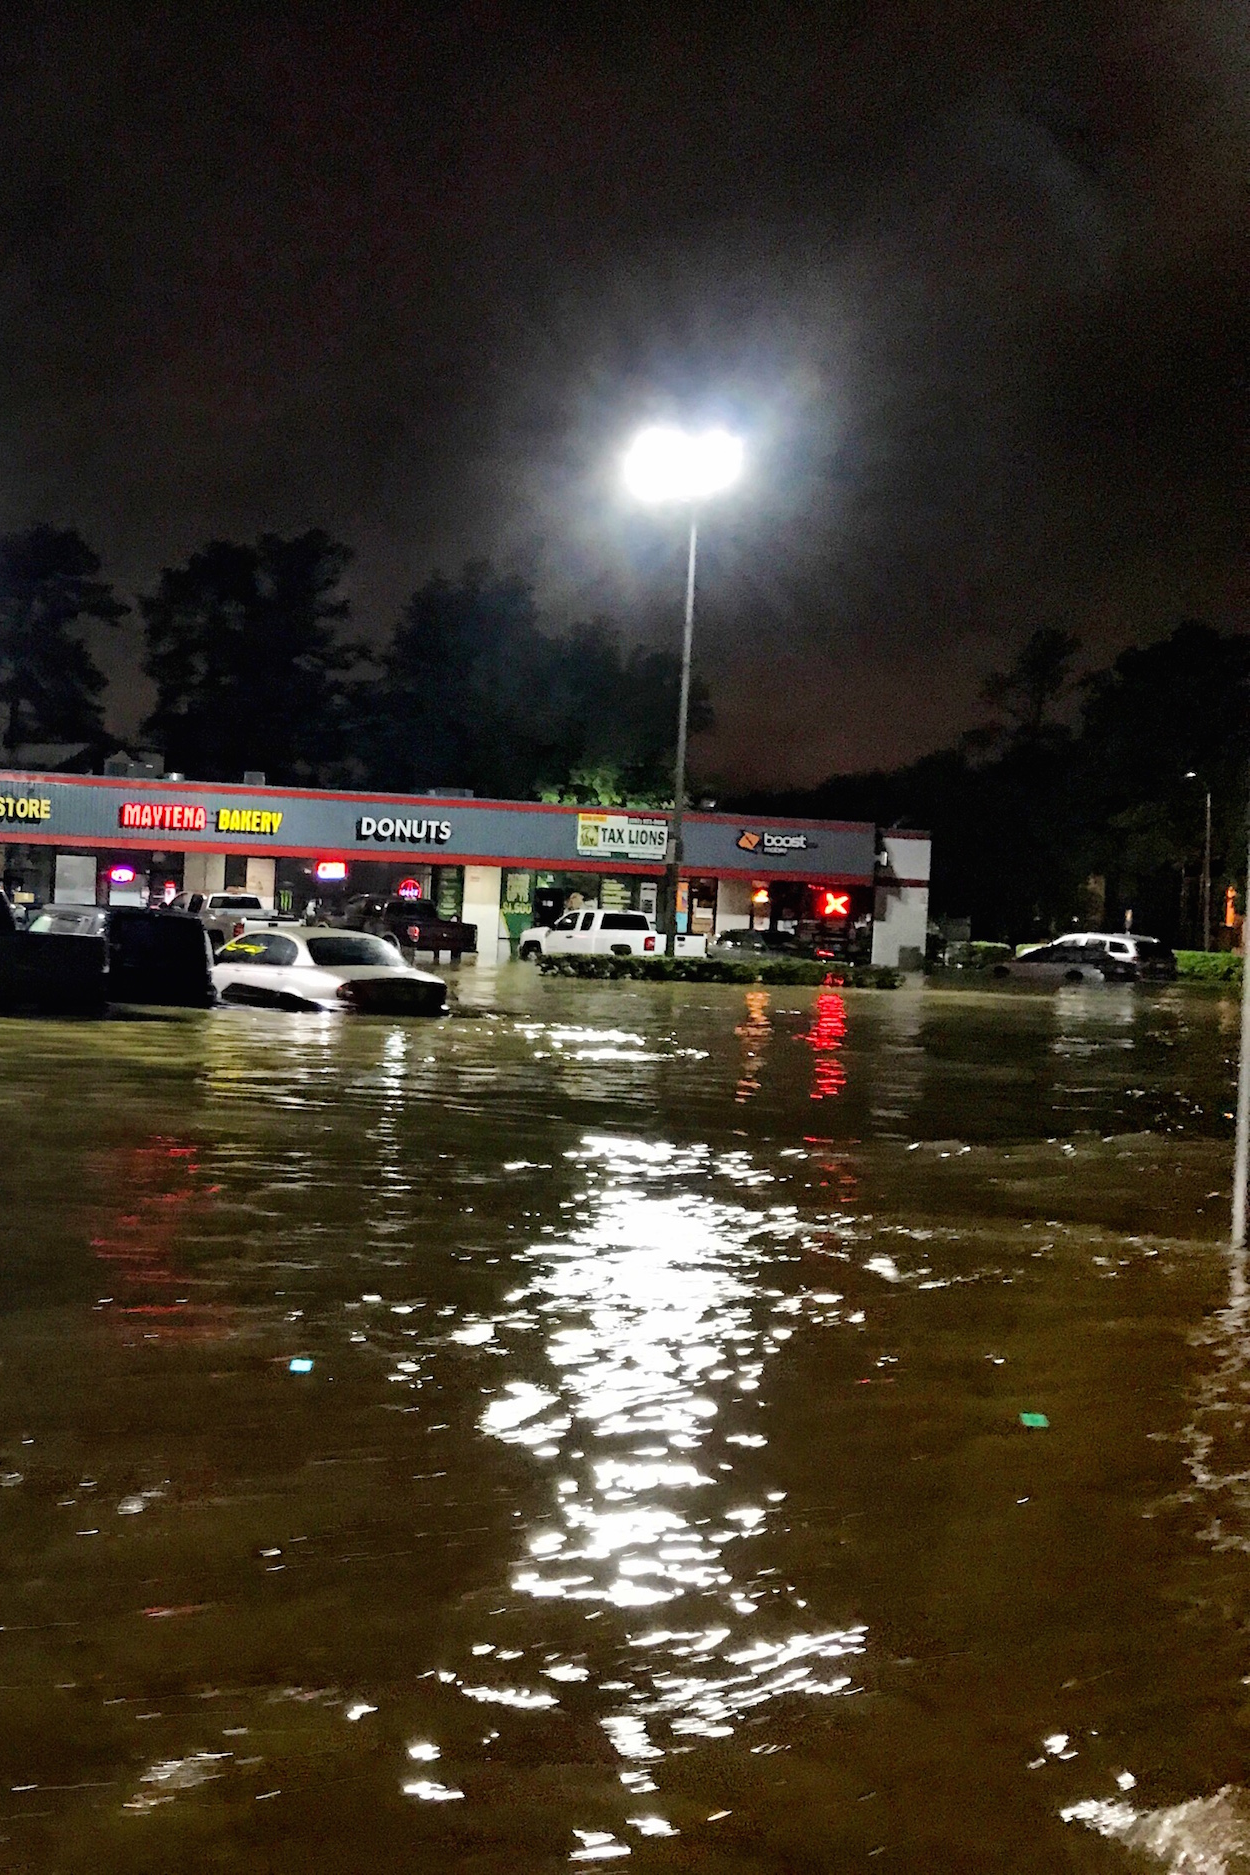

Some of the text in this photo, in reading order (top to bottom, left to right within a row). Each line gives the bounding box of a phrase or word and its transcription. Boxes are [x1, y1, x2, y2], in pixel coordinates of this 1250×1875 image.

[123, 803, 283, 834] MAYTENA BAKERY
[361, 816, 452, 840] DONUTS
[601, 827, 665, 846] TAX LIONS
[763, 832, 807, 848] boost
